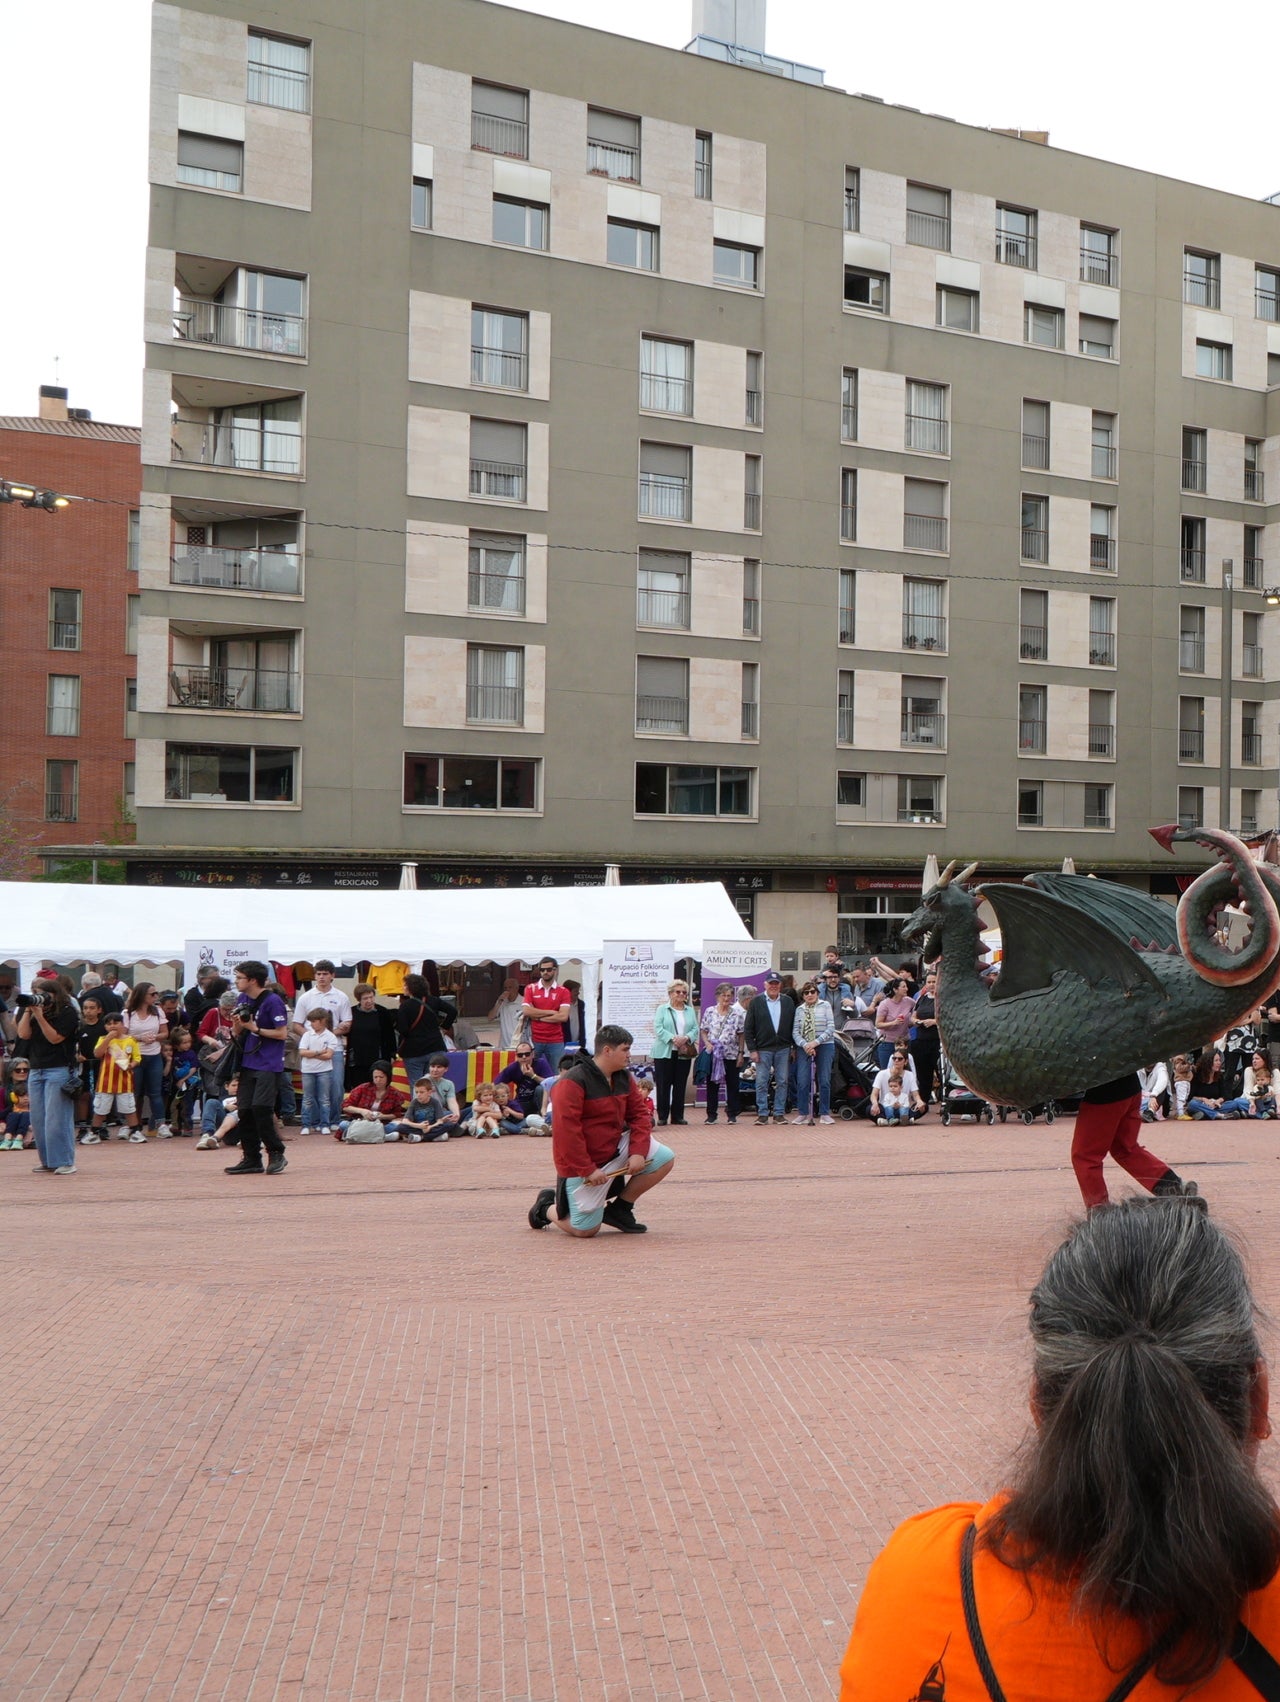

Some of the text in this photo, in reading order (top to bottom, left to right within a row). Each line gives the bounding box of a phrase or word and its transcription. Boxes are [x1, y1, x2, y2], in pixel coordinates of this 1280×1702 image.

[226, 949, 249, 957] Esbart
[223, 959, 242, 968] Egar
[706, 956, 736, 964] AMUNT
[744, 956, 768, 965] CRITS
[608, 963, 640, 971] Agrupació
[620, 970, 640, 978] Amunt
[643, 970, 659, 978] Crits
